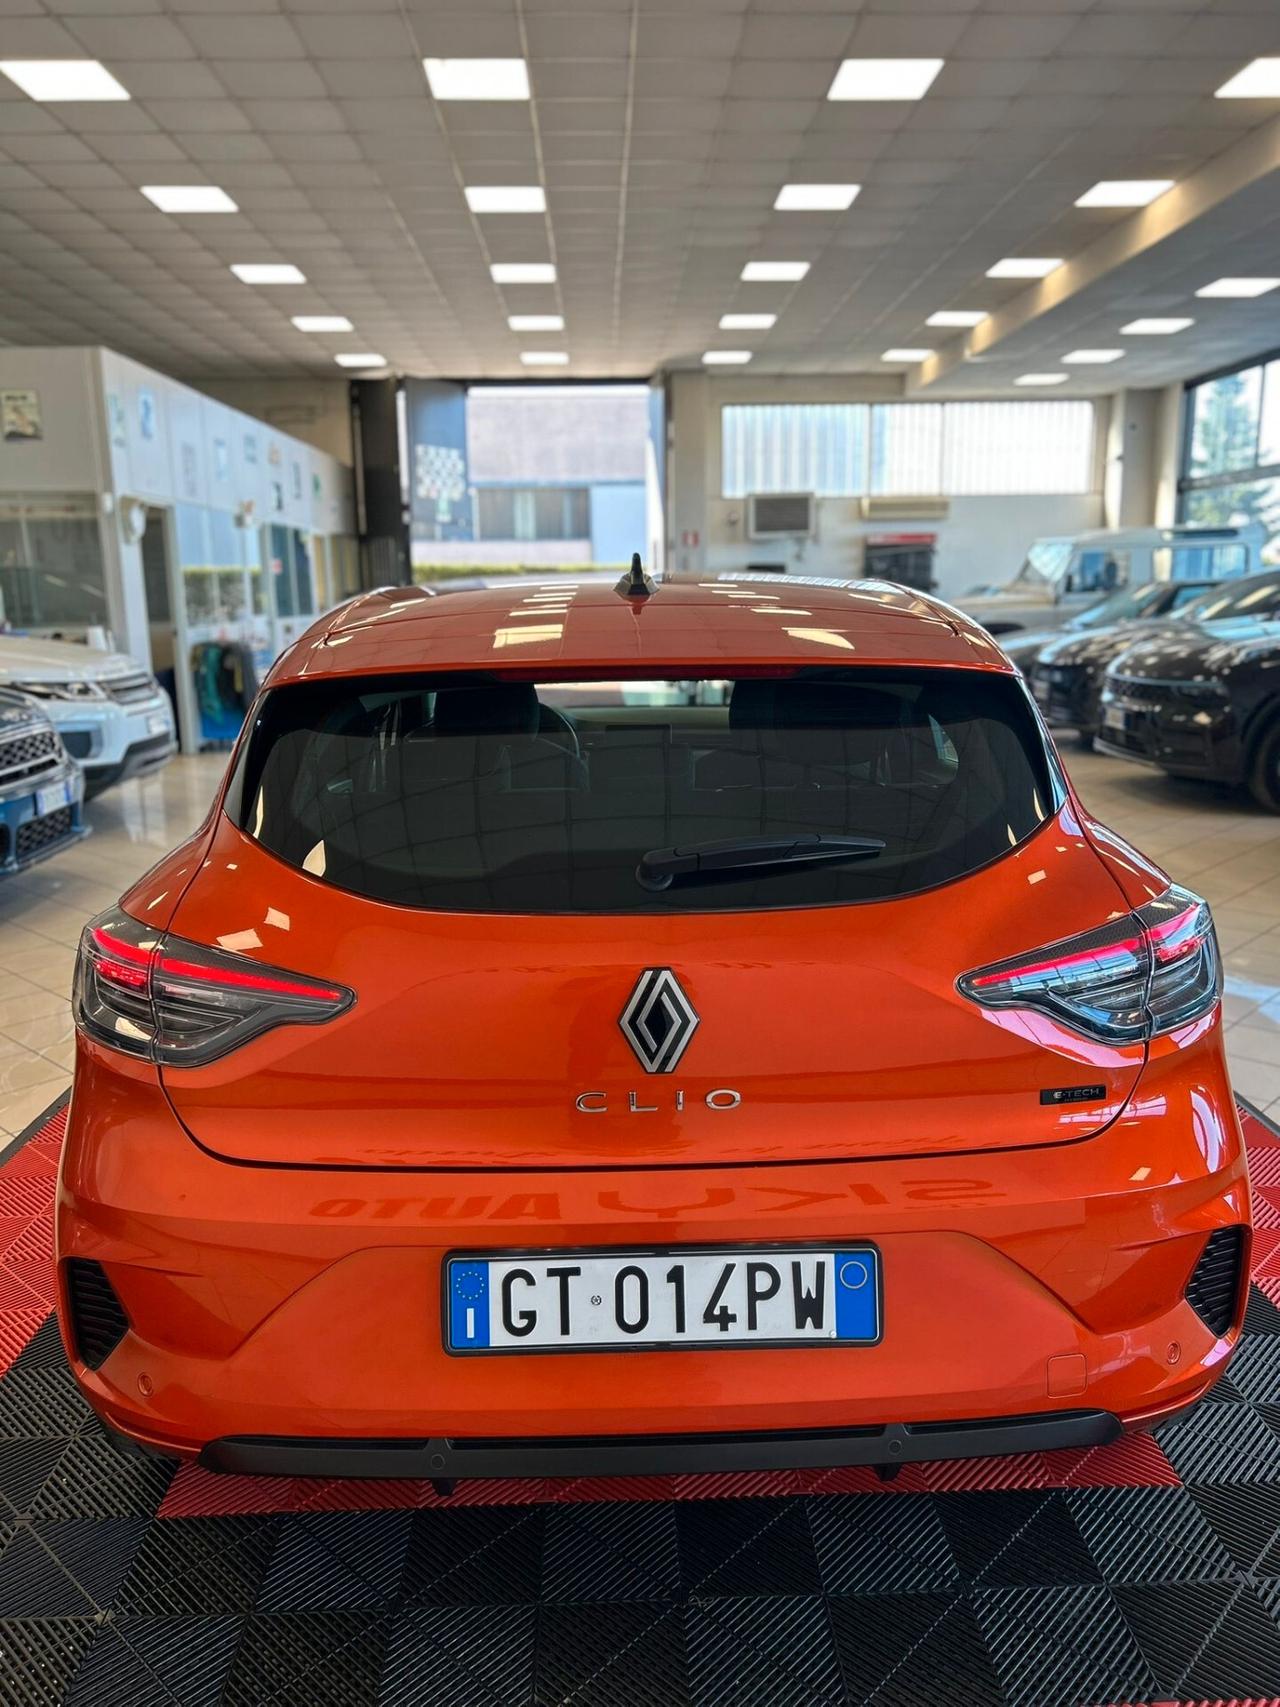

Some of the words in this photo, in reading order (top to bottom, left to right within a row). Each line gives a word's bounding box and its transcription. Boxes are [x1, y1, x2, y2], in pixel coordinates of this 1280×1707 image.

[575, 1088, 743, 1113] CLIO
[500, 1266, 582, 1337] GT
[613, 1260, 826, 1335] 014PW
